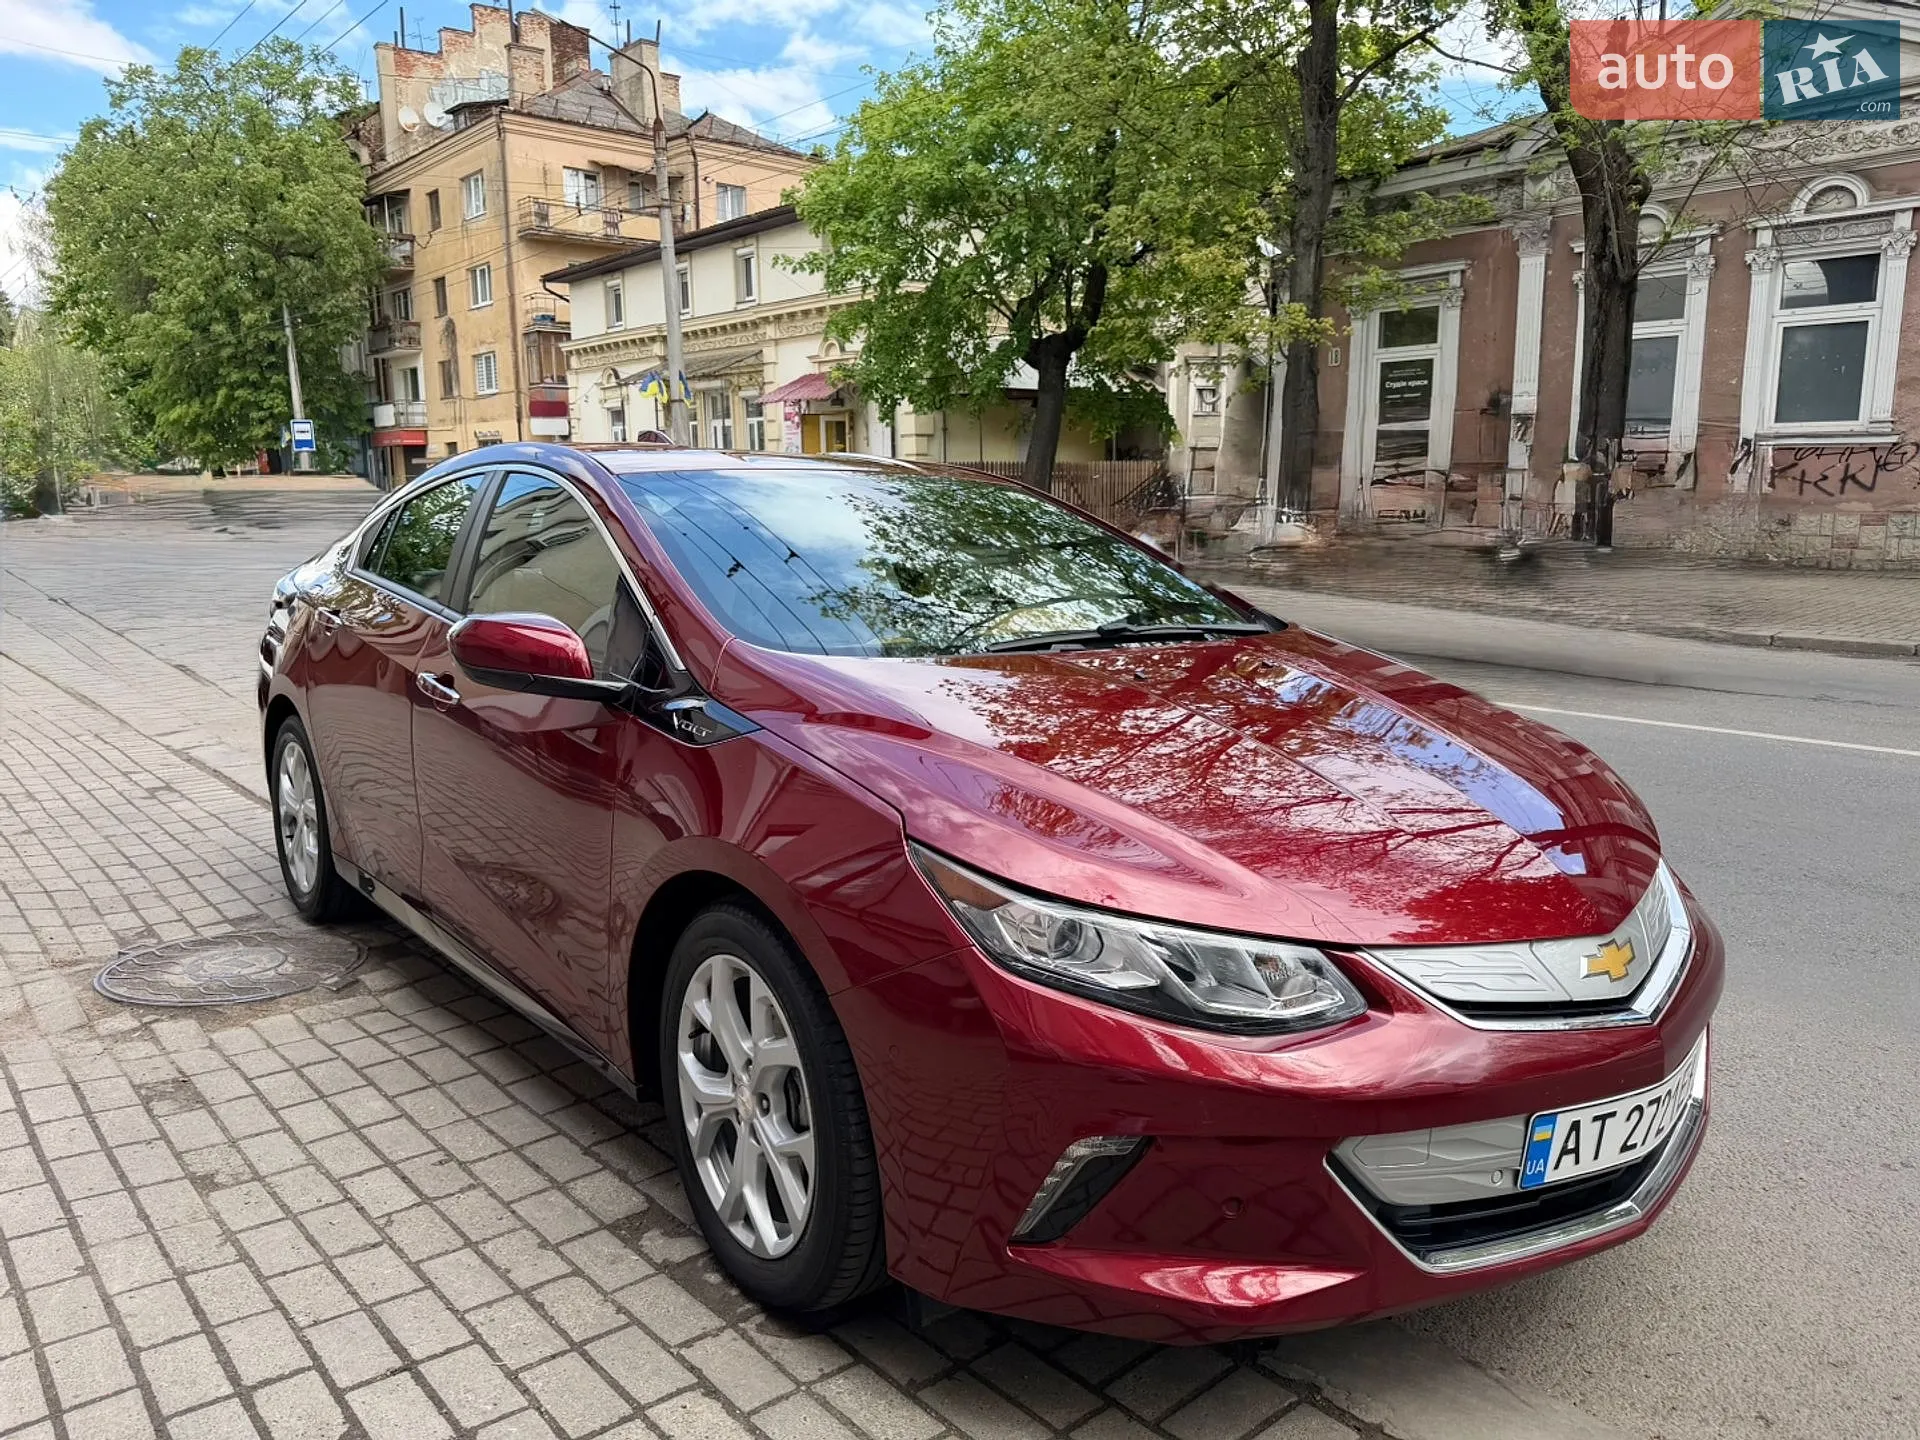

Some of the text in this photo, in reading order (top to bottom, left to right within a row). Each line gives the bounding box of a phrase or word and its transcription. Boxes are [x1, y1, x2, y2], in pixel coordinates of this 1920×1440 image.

[673, 712, 712, 737] VOLT
[1552, 1110, 1617, 1171] AT
[1526, 1158, 1545, 1175] UA
